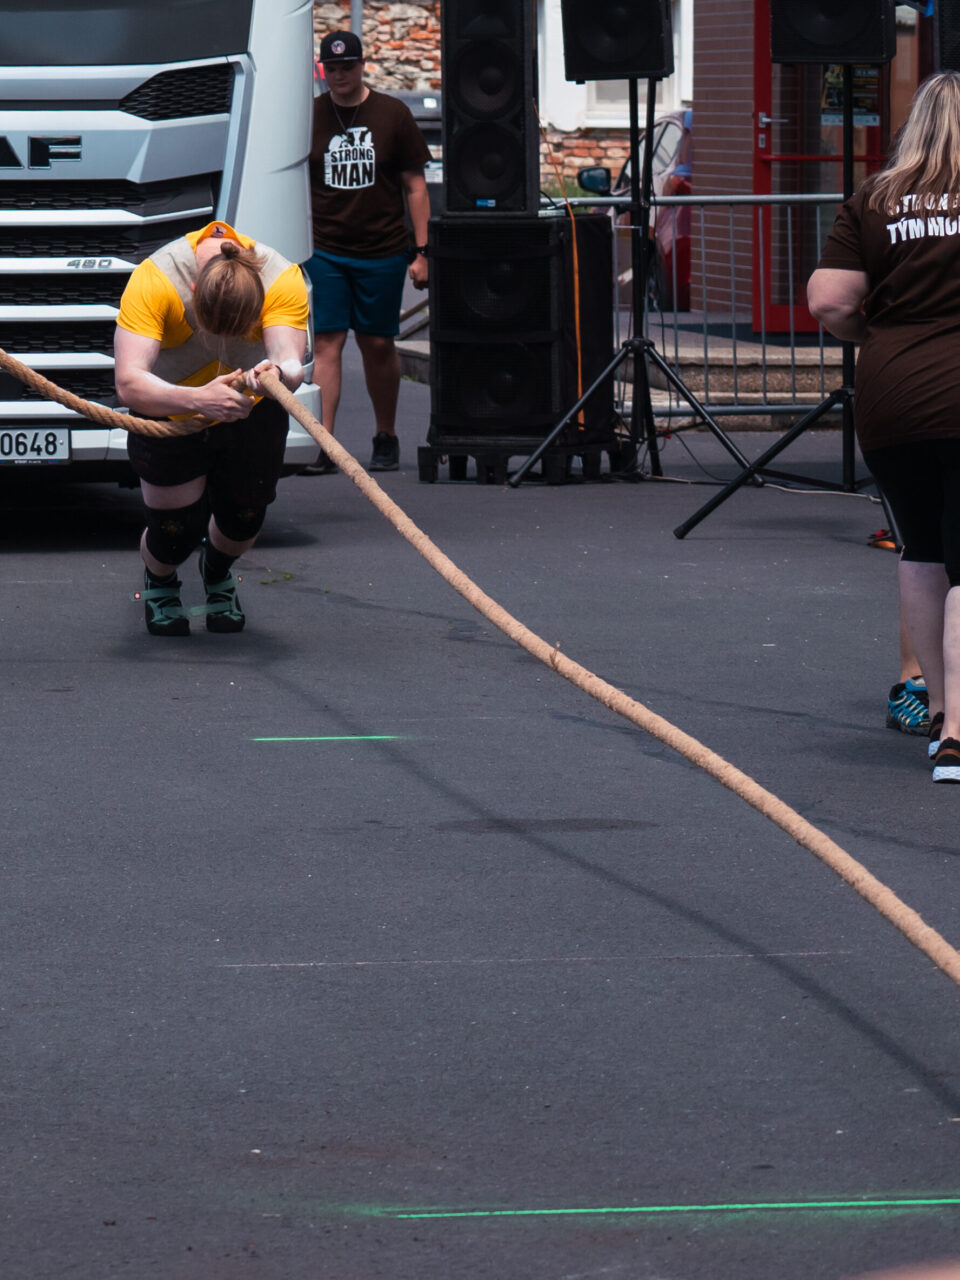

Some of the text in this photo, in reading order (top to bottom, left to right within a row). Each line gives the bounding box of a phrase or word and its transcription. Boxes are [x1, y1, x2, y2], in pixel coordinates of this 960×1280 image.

[330, 147, 373, 162] STRONG
[331, 161, 373, 187] MAN
[886, 215, 960, 244] TÝM MO
[66, 259, 113, 269] 480
[0, 432, 58, 456] 0648
